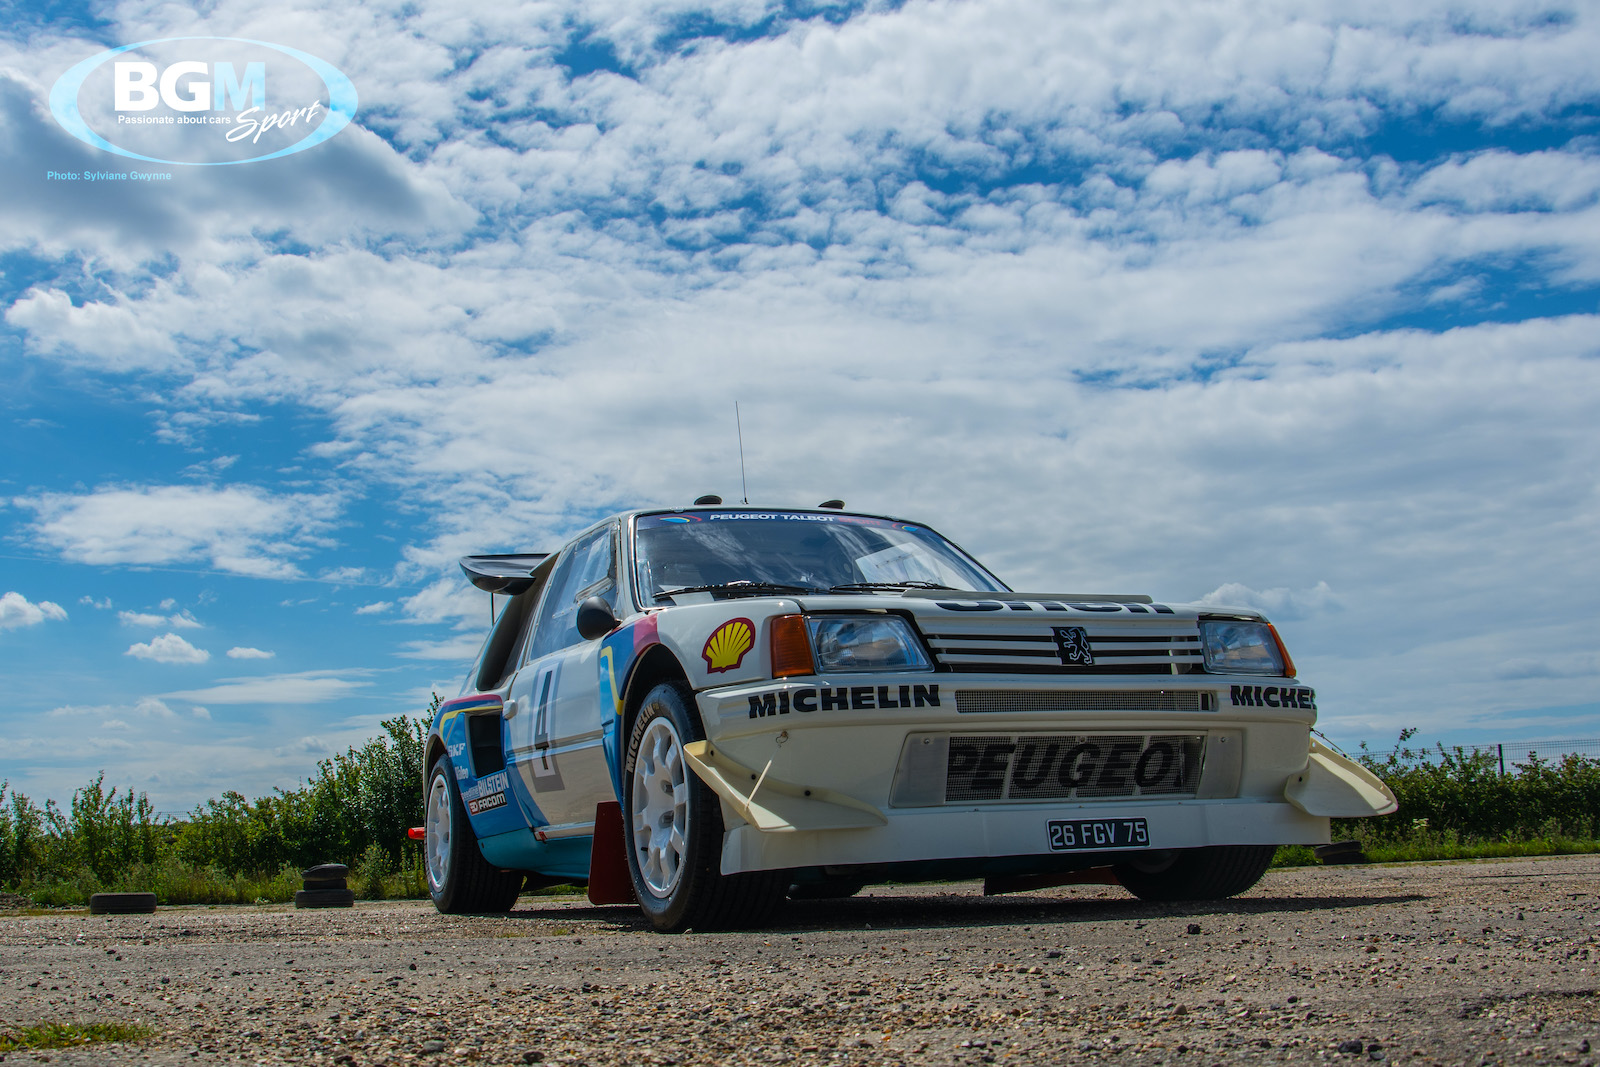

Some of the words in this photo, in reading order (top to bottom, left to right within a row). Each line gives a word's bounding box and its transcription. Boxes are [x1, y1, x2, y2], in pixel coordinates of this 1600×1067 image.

[780, 514, 835, 522] TALBOT
[748, 684, 941, 719] MICHELIN
[534, 670, 553, 770] 4
[448, 743, 465, 757] SKF
[626, 703, 655, 773] MICHELIN
[948, 742, 1183, 790] PEUGEO
[478, 772, 509, 798] BILSTEIN
[1050, 824, 1075, 847] 26
[1081, 823, 1116, 845] FGV
[1123, 821, 1147, 843] 75
